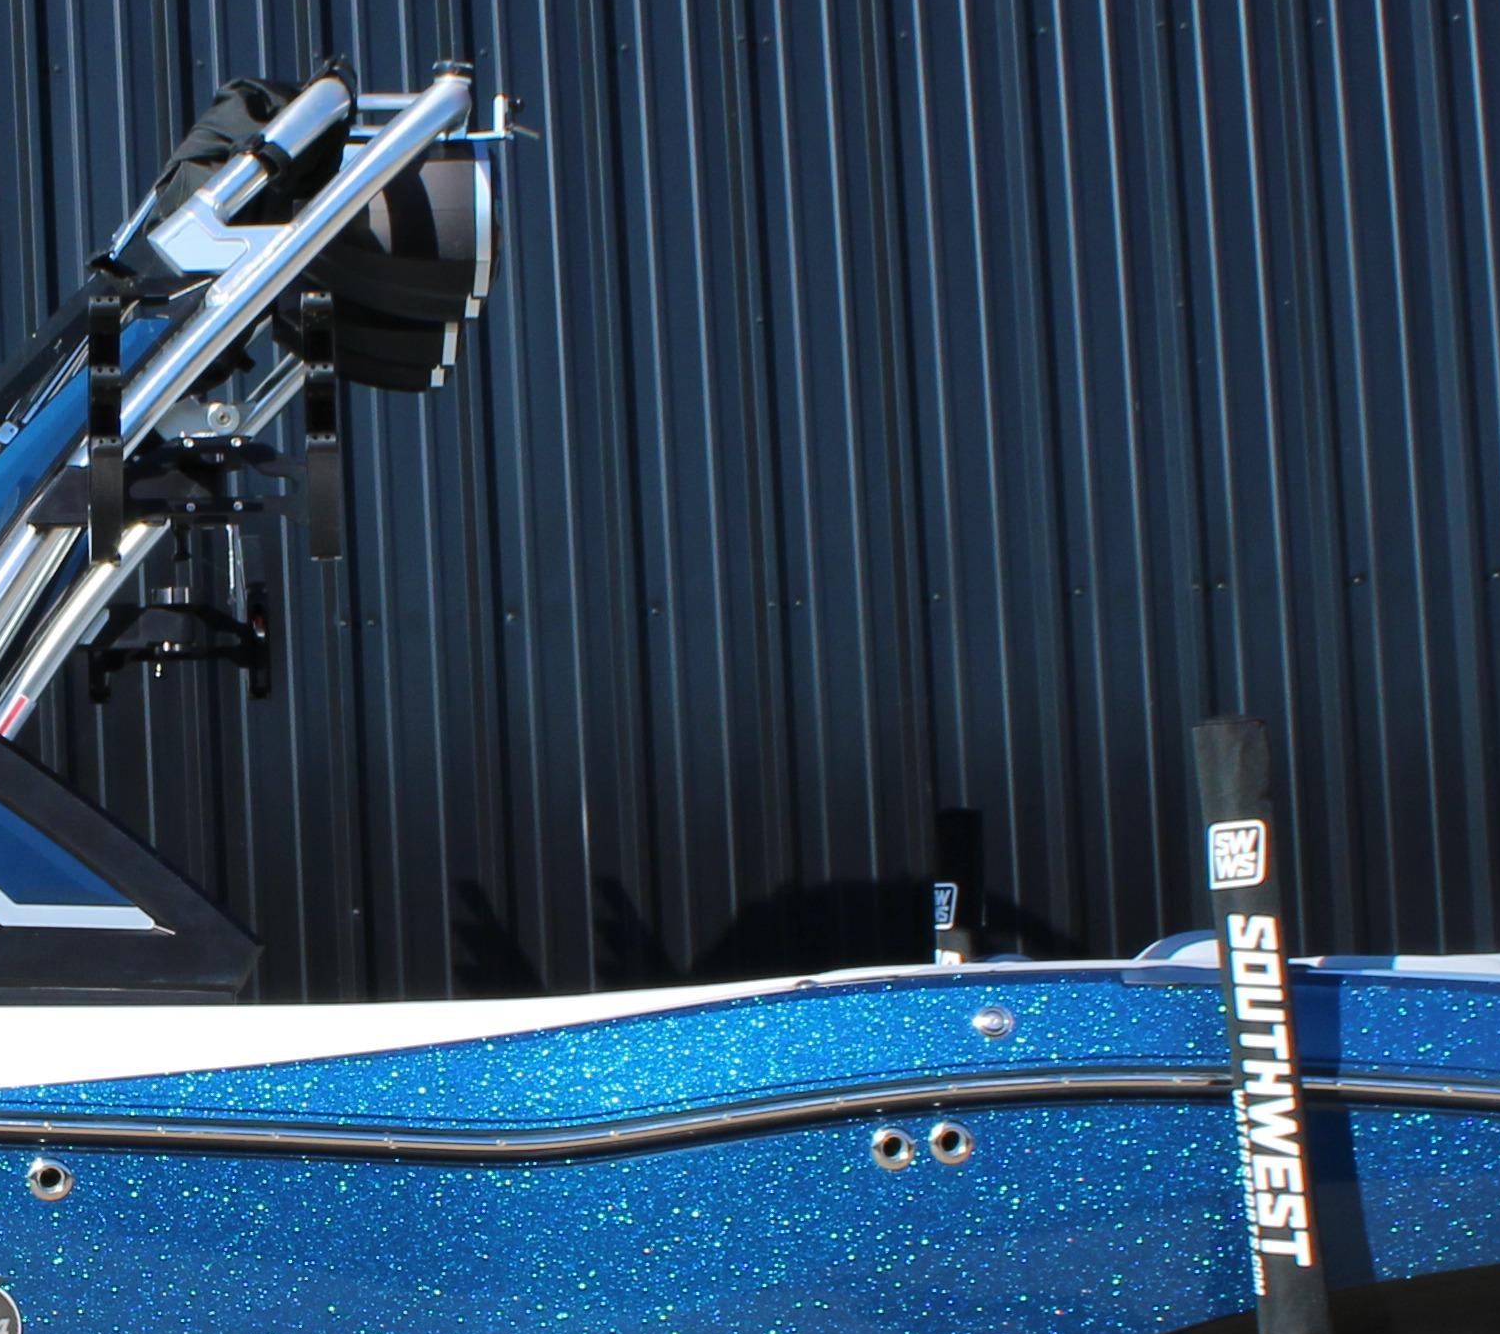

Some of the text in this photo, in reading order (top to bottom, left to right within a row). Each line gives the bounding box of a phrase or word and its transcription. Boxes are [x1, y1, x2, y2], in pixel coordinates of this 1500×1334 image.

[1213, 828, 1258, 856] SW
[1214, 851, 1258, 880] WS
[1226, 913, 1313, 1267] SOUTHWEST
